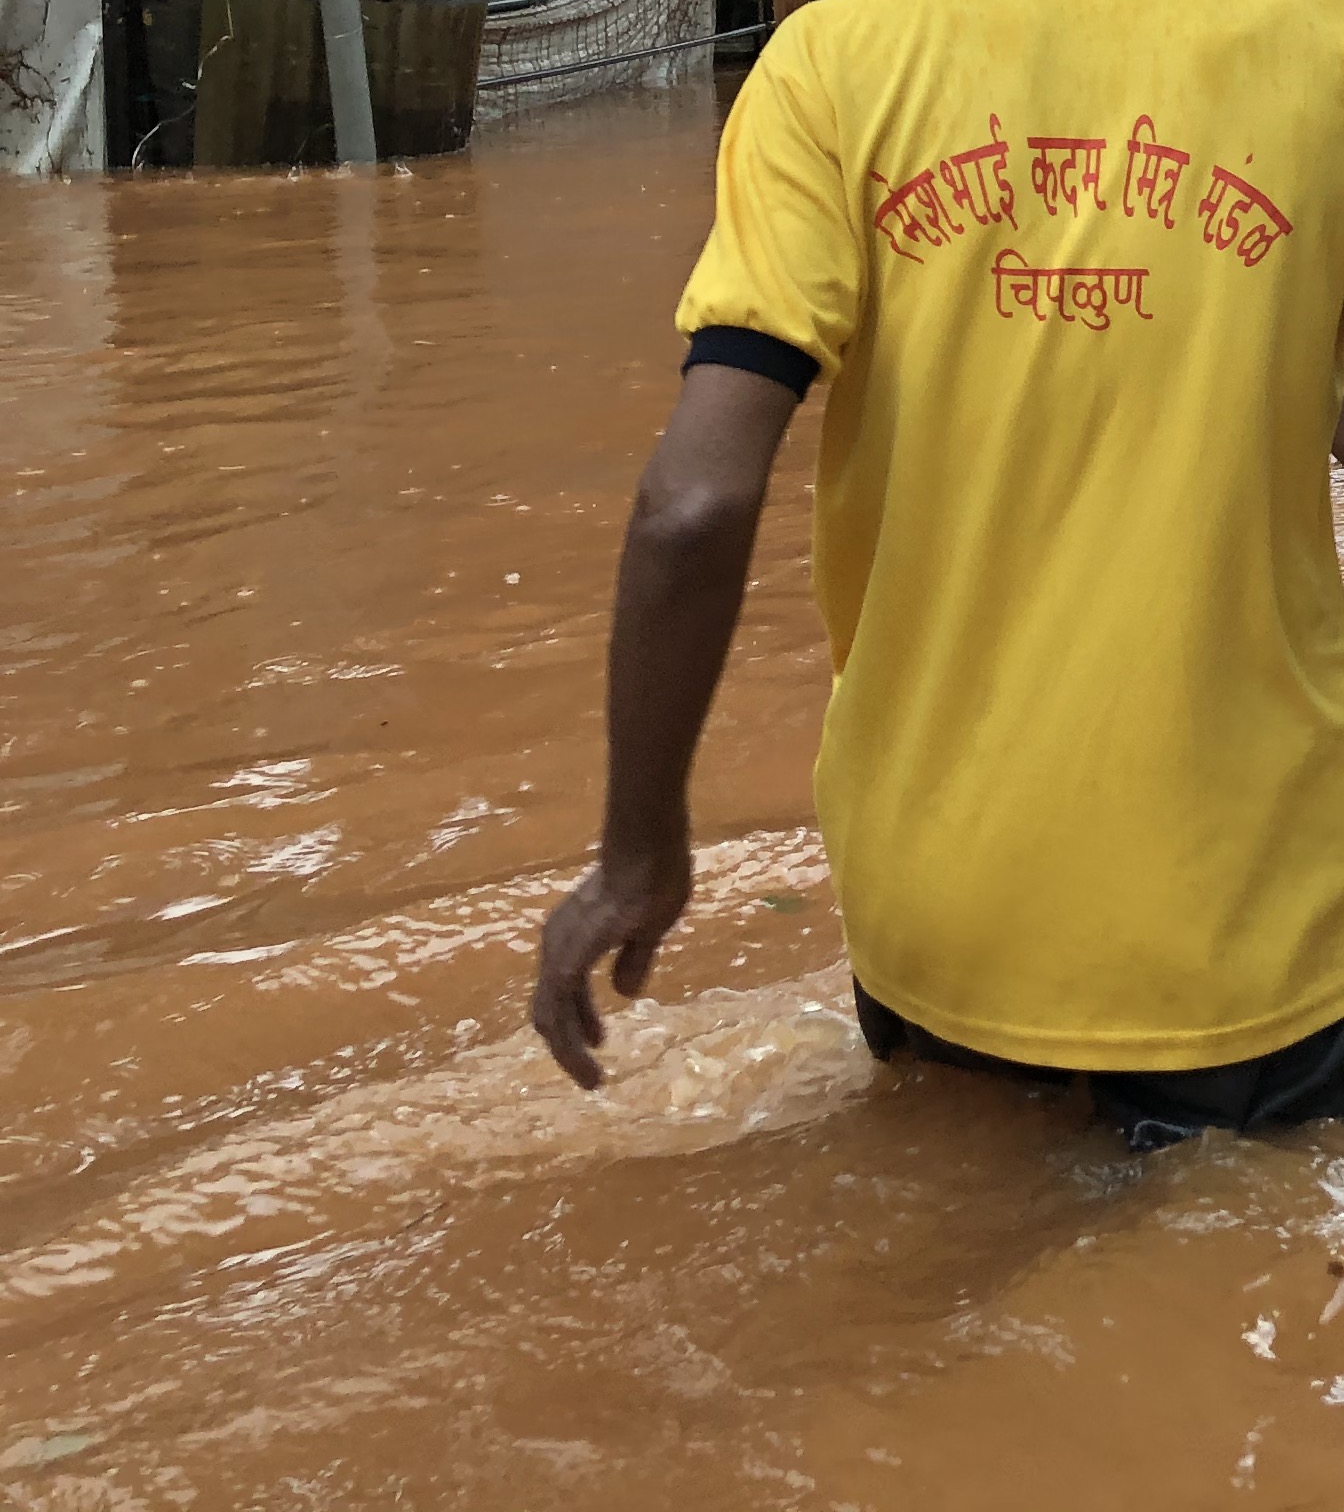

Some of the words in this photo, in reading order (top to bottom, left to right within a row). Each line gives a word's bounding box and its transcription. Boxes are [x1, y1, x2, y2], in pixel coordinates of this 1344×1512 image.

[1026, 137, 1108, 217] कदम
[1123, 114, 1191, 230] मित्र
[1198, 153, 1294, 267] मंडळ
[991, 248, 1154, 331] चिपळुण
